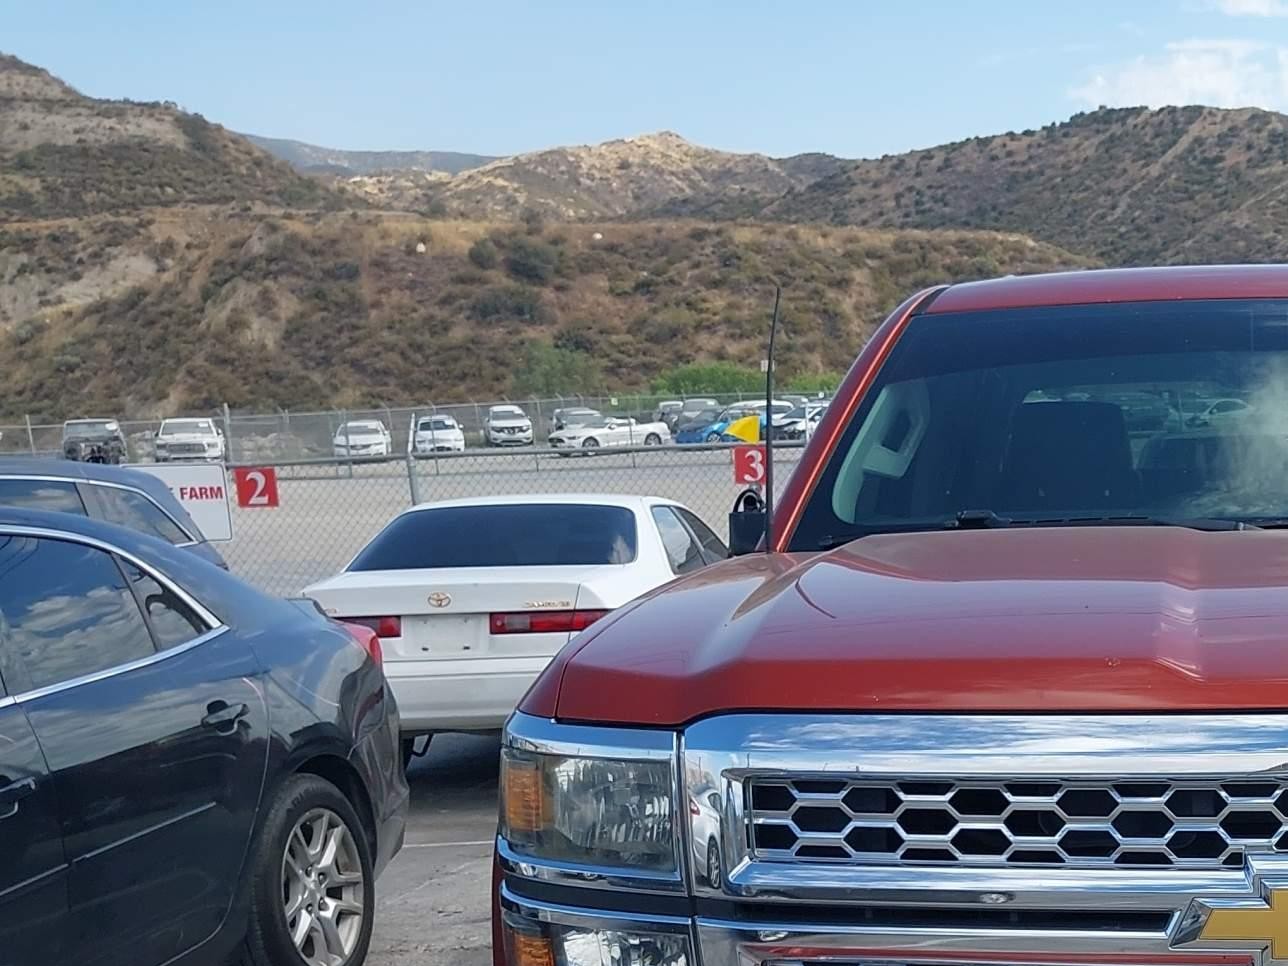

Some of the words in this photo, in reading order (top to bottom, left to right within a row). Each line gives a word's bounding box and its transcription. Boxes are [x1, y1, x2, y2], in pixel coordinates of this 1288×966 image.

[743, 450, 765, 482] 3
[179, 485, 224, 501] FARM
[245, 471, 270, 505] 2
